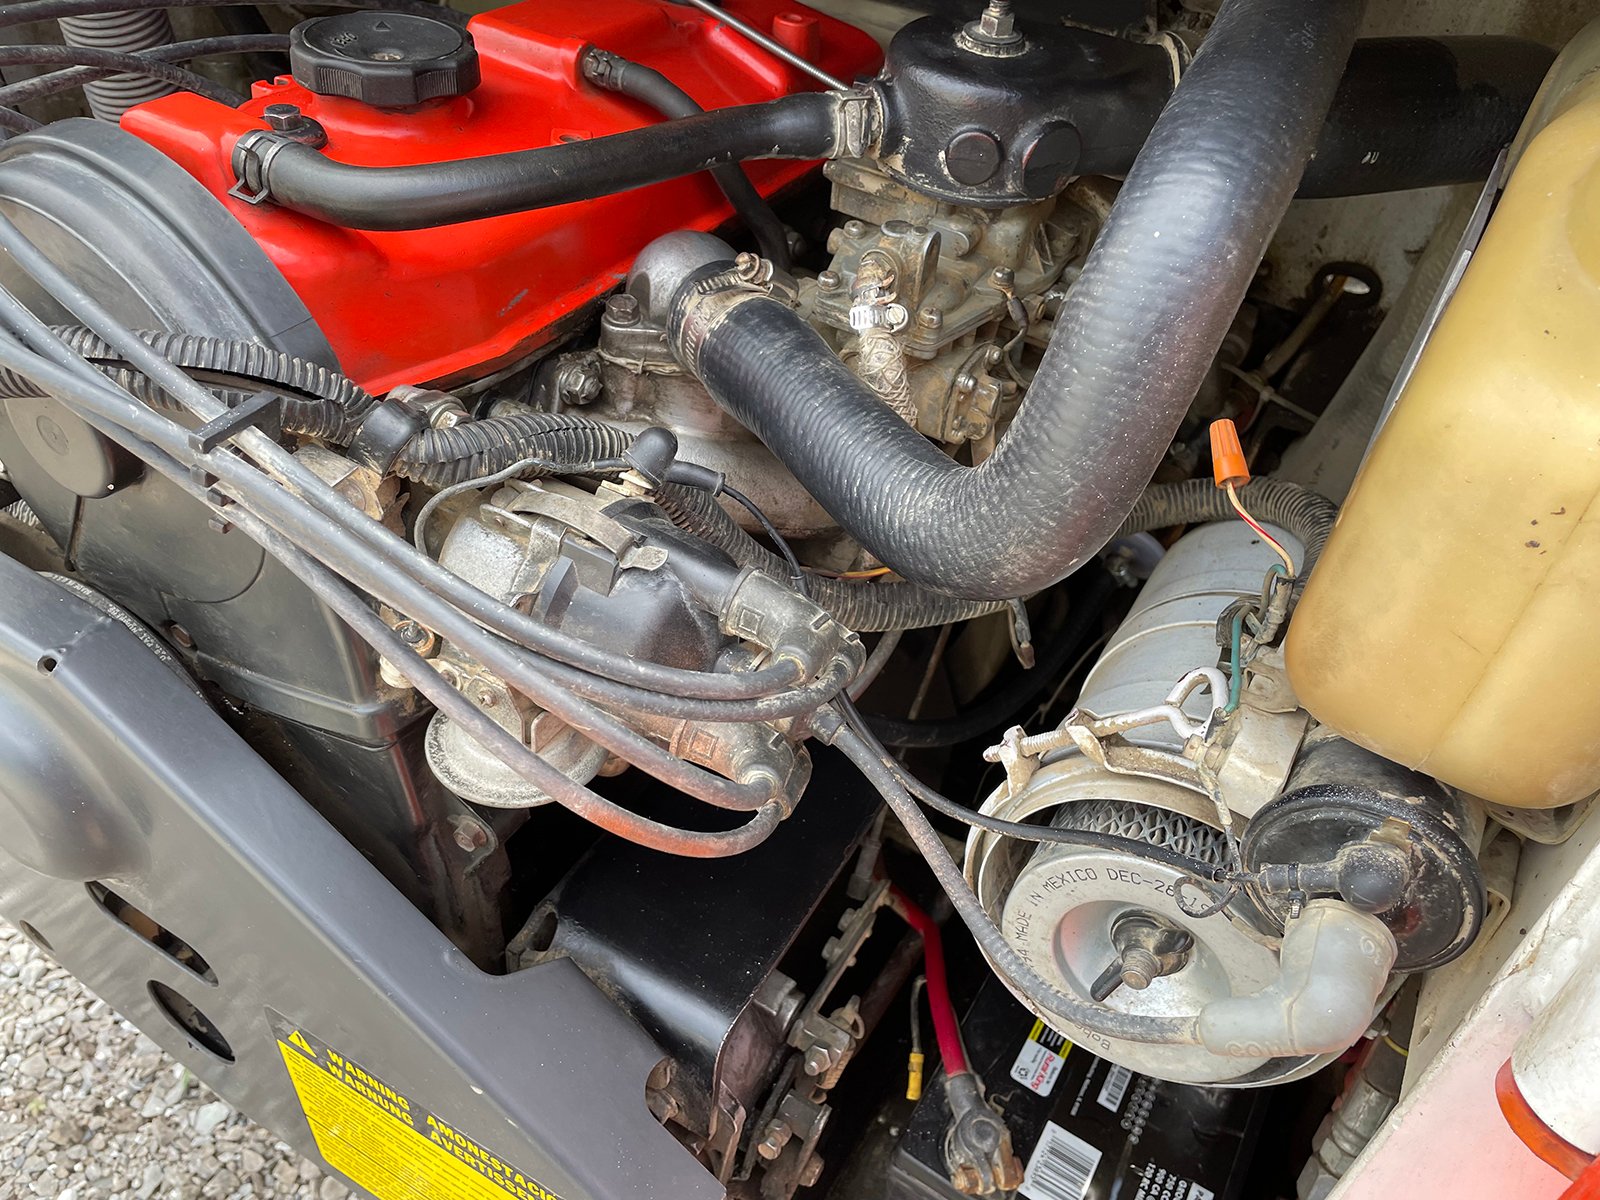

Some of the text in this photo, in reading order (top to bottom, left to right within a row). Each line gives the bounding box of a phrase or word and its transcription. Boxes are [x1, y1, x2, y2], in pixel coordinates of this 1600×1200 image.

[1015, 910, 1032, 942] MADE
[1026, 890, 1044, 907] IN
[1042, 867, 1098, 893] MEXICO
[326, 1061, 414, 1126] WARNUNG
[327, 1048, 411, 1111] WARNING
